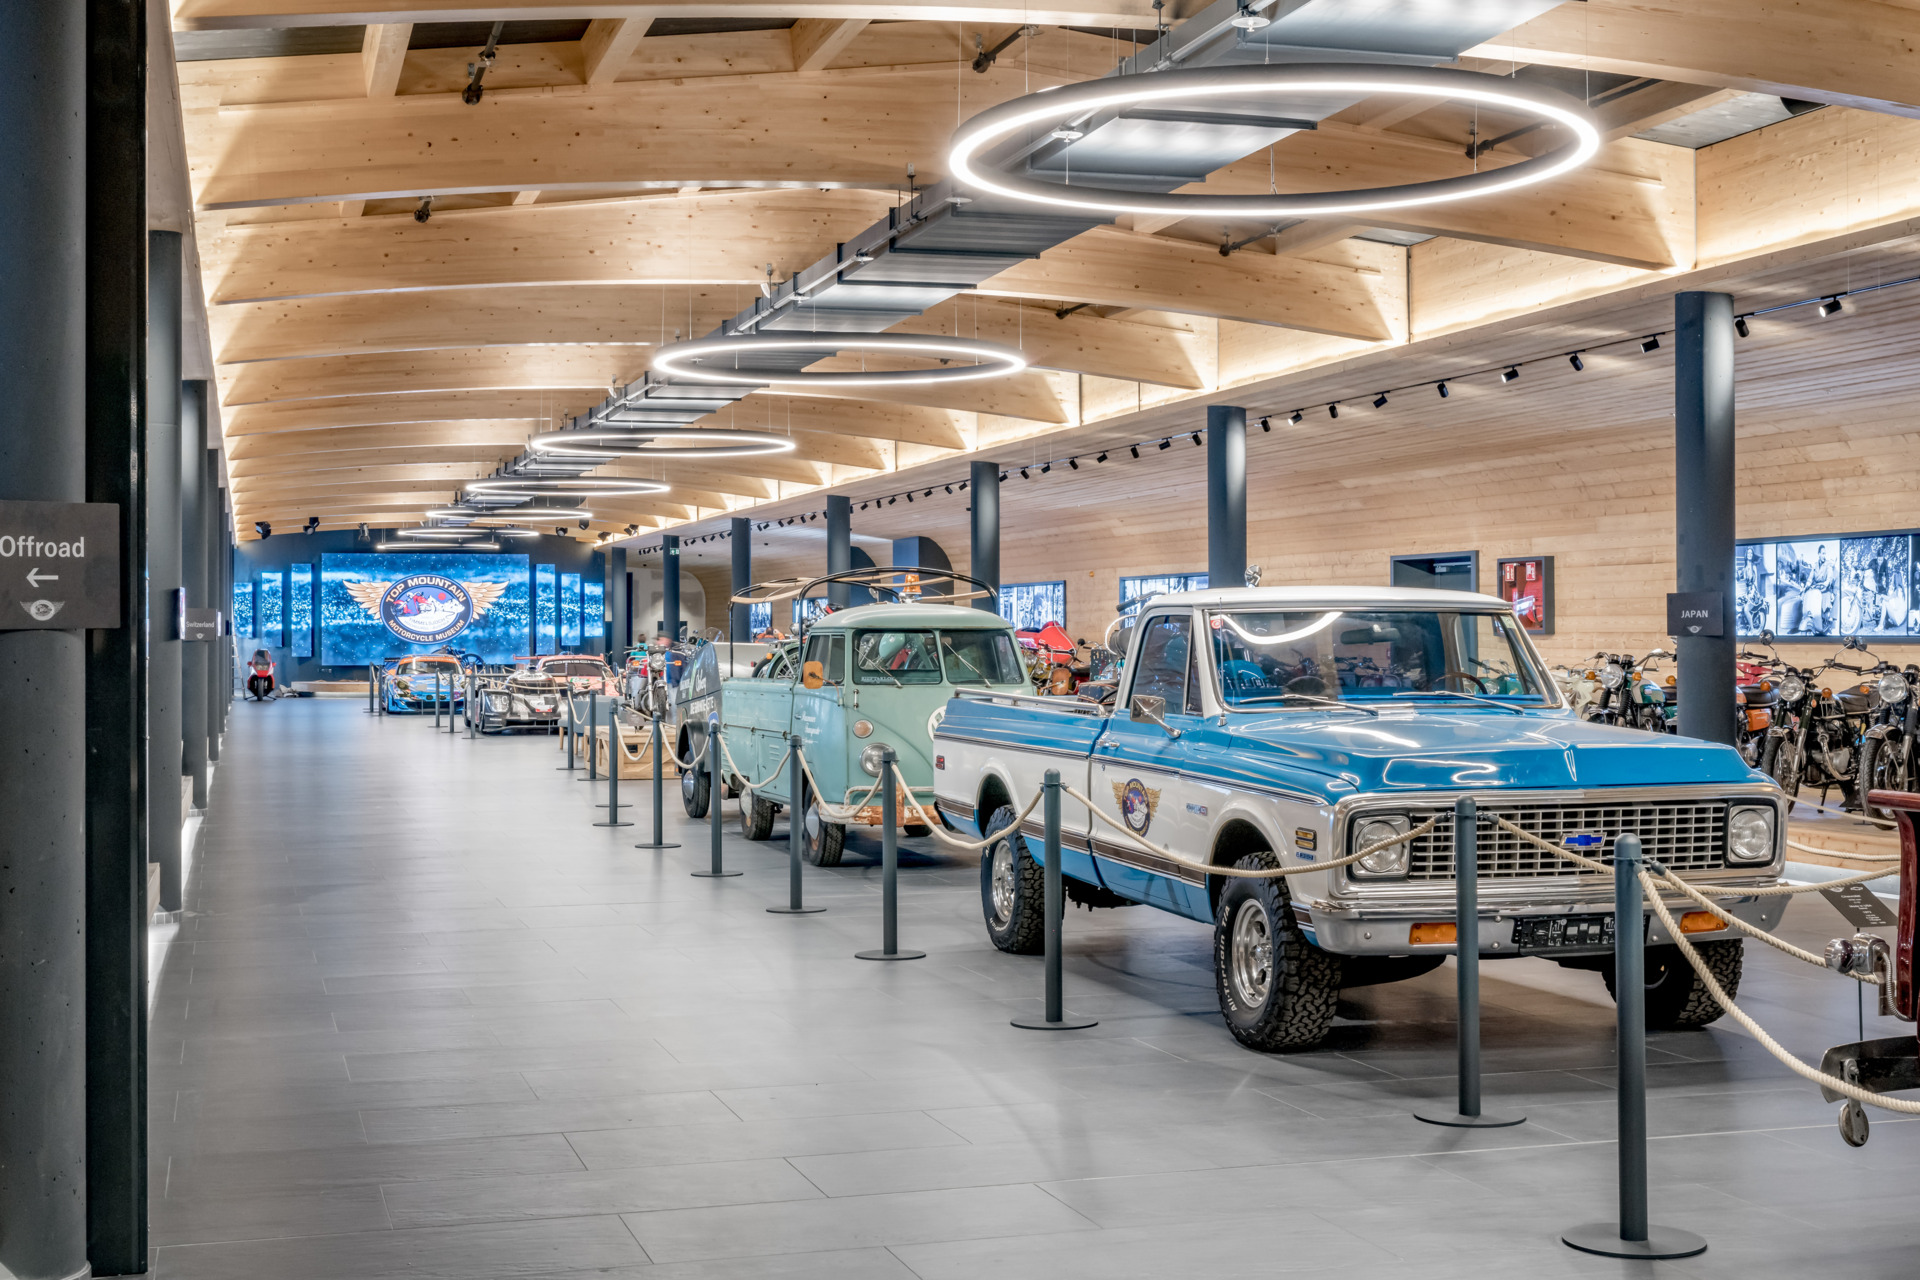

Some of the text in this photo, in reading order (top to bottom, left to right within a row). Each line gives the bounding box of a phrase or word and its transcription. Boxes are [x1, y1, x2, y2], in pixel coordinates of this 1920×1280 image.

[0, 535, 85, 558] Offroad
[385, 576, 467, 603] TOP MOUNTAIN
[1681, 609, 1709, 619] JAPAN
[388, 619, 434, 642] MOTORCYCLE
[435, 619, 465, 641] MUSEUM
[1220, 905, 1238, 1012] All-Terrain T/A
